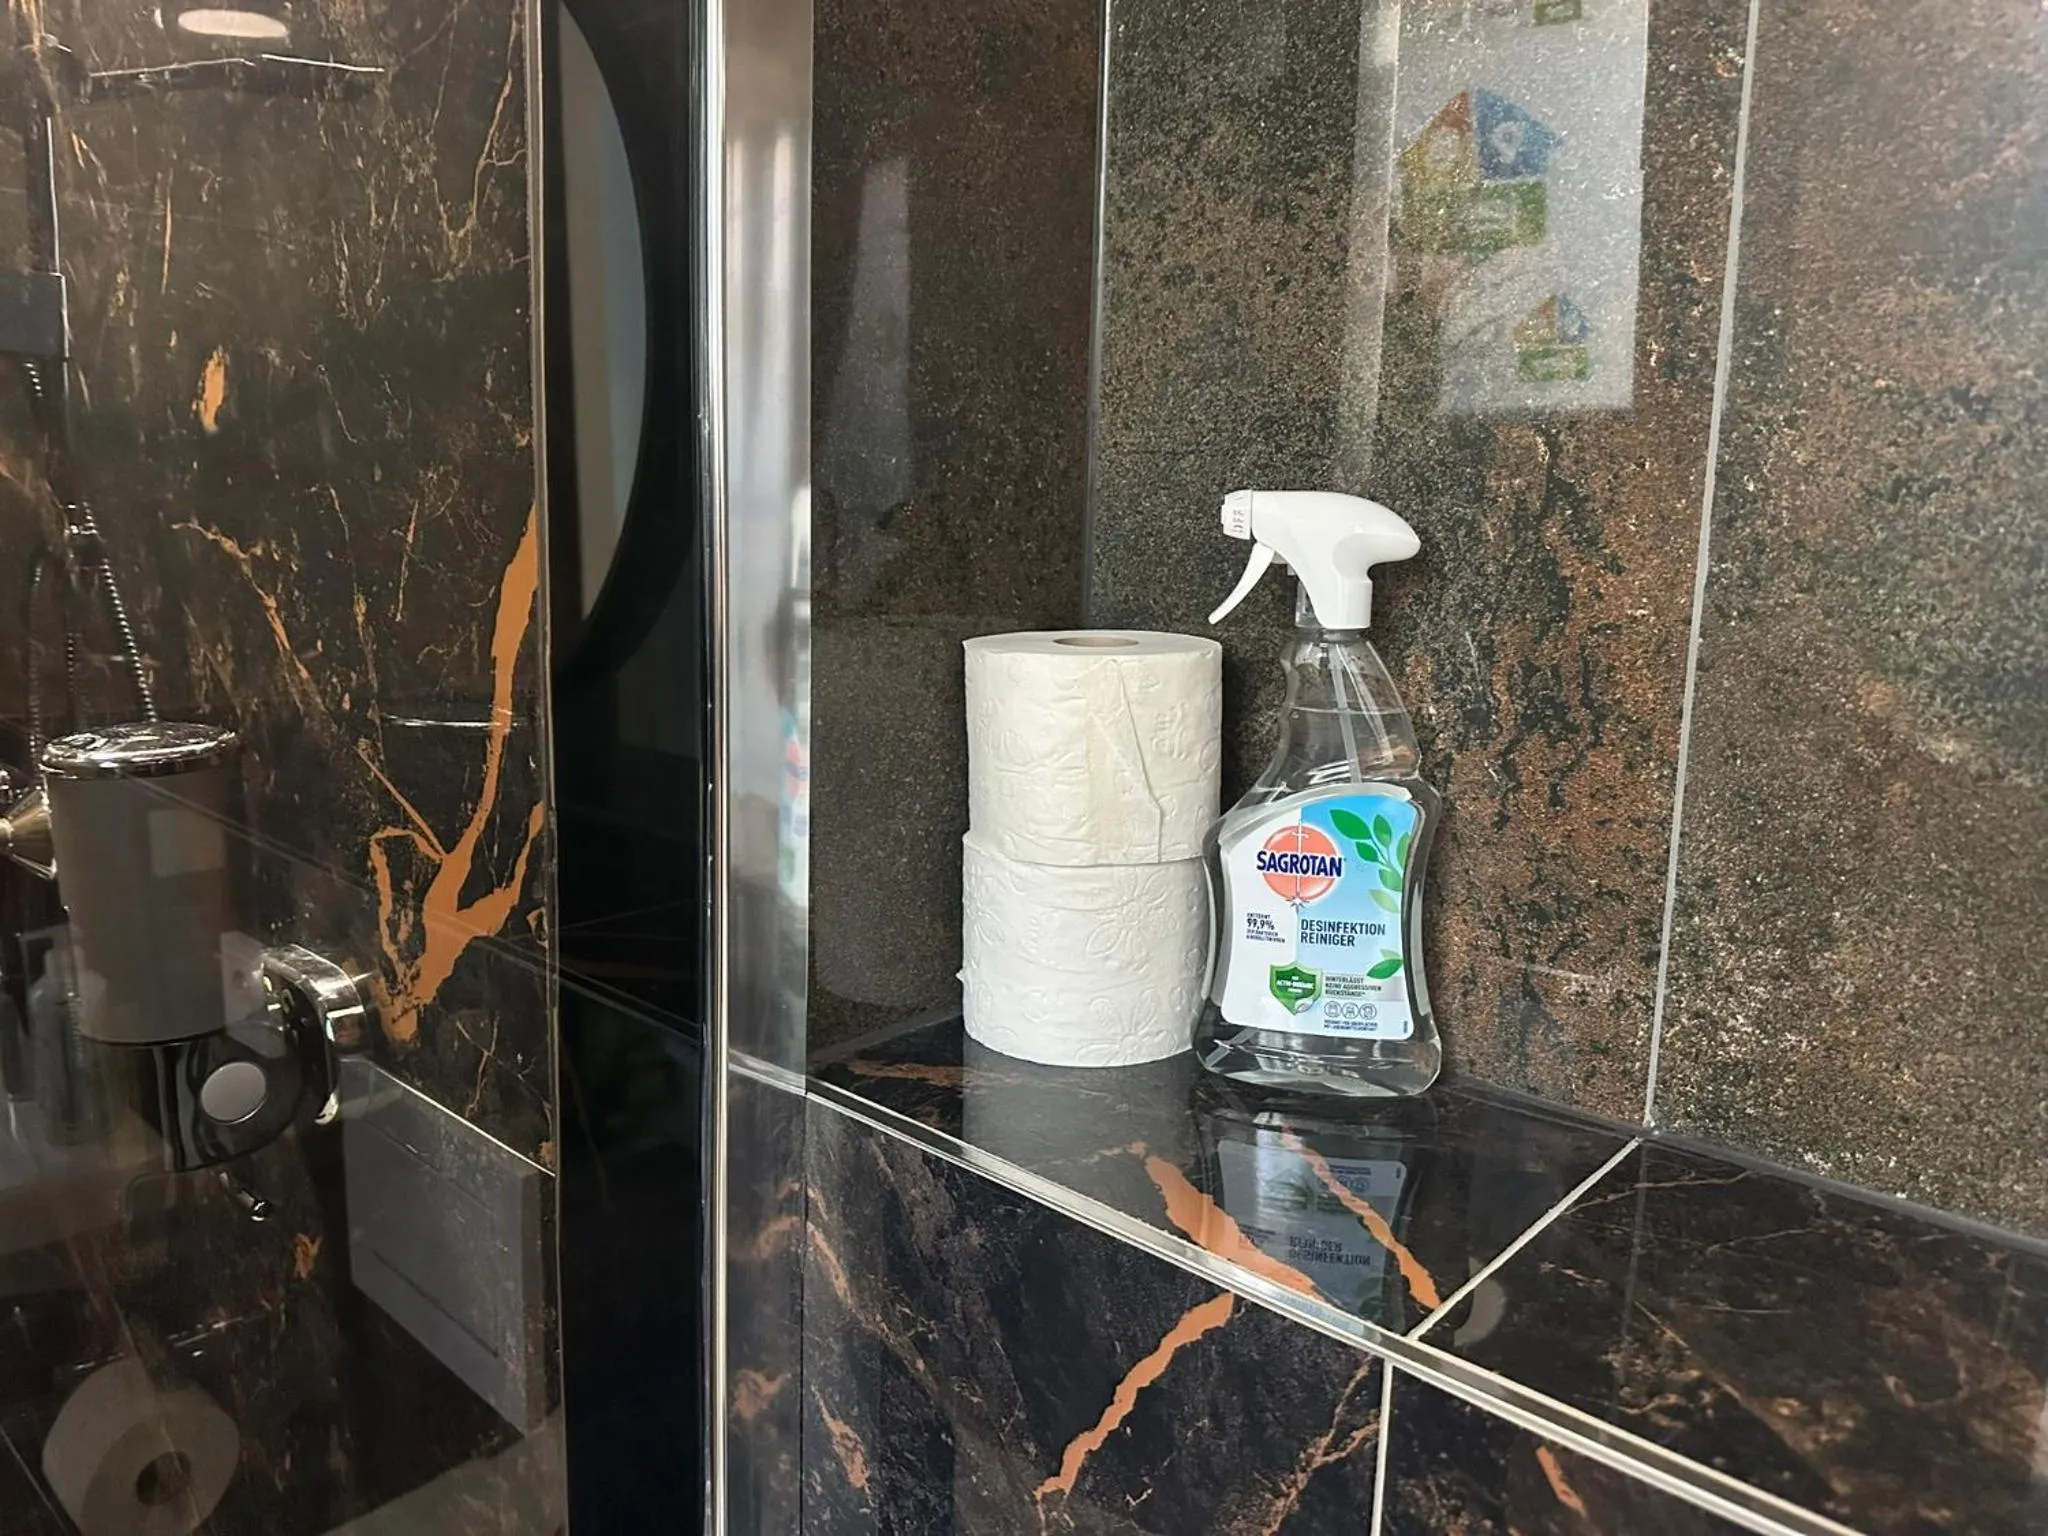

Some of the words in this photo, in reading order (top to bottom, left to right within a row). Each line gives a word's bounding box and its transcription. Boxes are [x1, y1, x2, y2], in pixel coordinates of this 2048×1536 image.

[1256, 850, 1342, 877] SAGROTAN
[1247, 918, 1275, 930] 99,9%
[1301, 919, 1386, 935] DESINFEKTION
[1301, 931, 1355, 947] REINIGER
